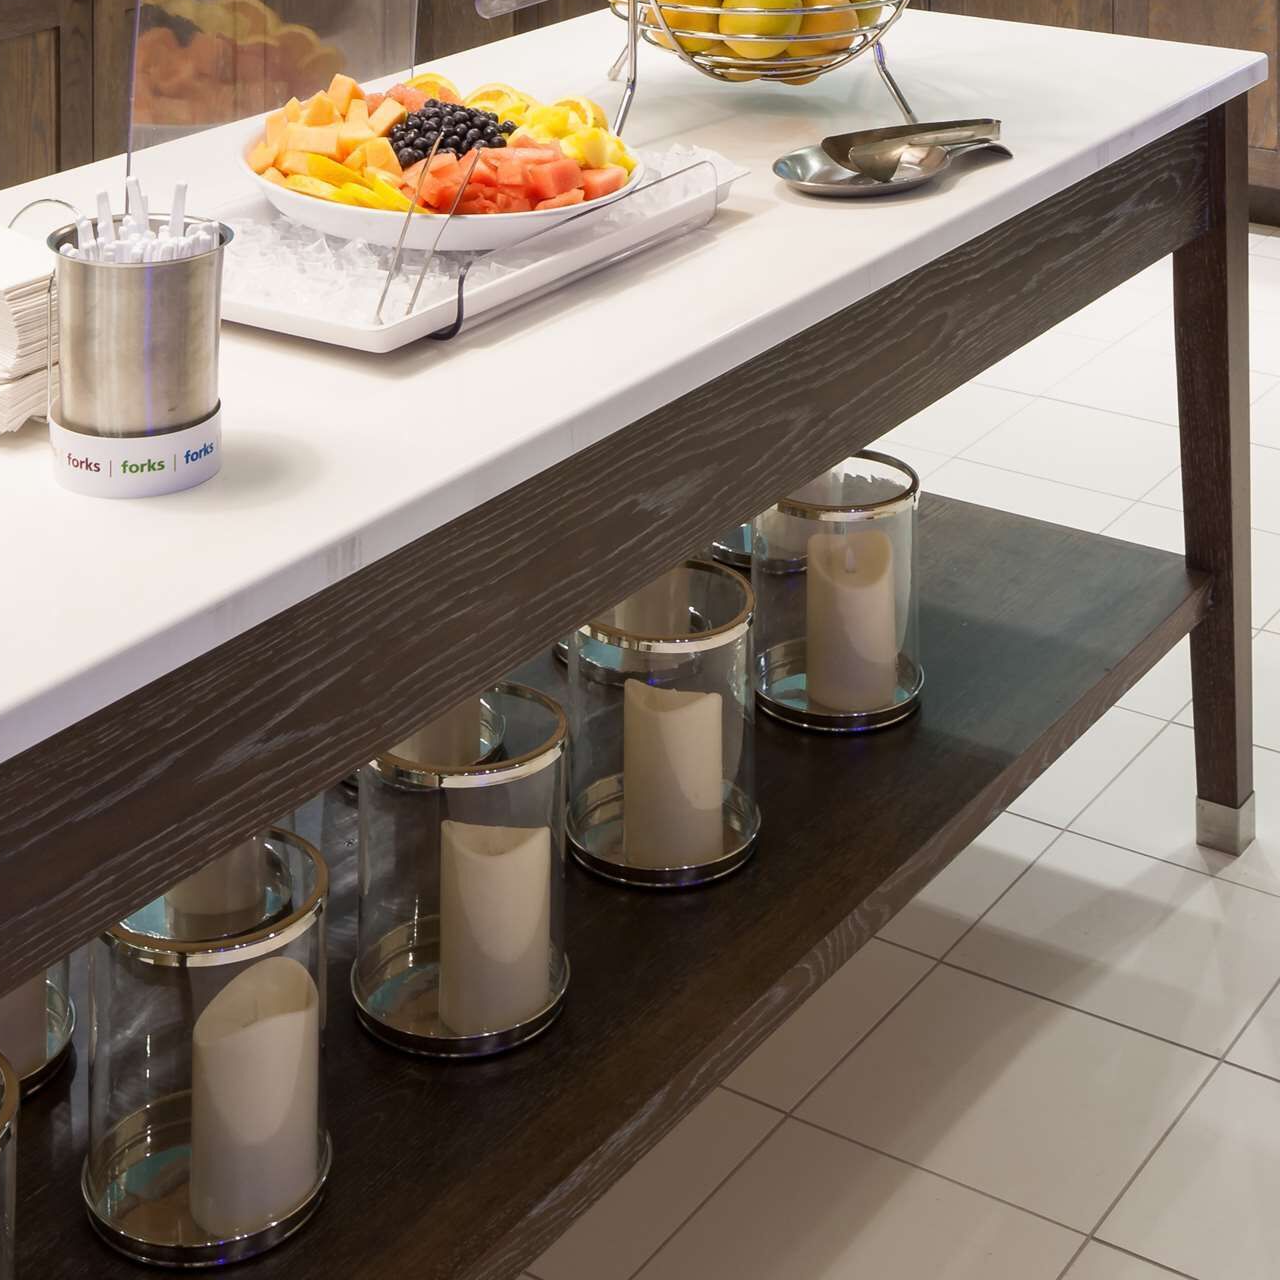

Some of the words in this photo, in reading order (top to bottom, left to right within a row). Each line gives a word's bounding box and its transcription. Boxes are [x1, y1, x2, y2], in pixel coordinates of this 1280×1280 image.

[67, 452, 101, 473] forks
[120, 459, 166, 474] forks
[184, 440, 214, 465] forks
